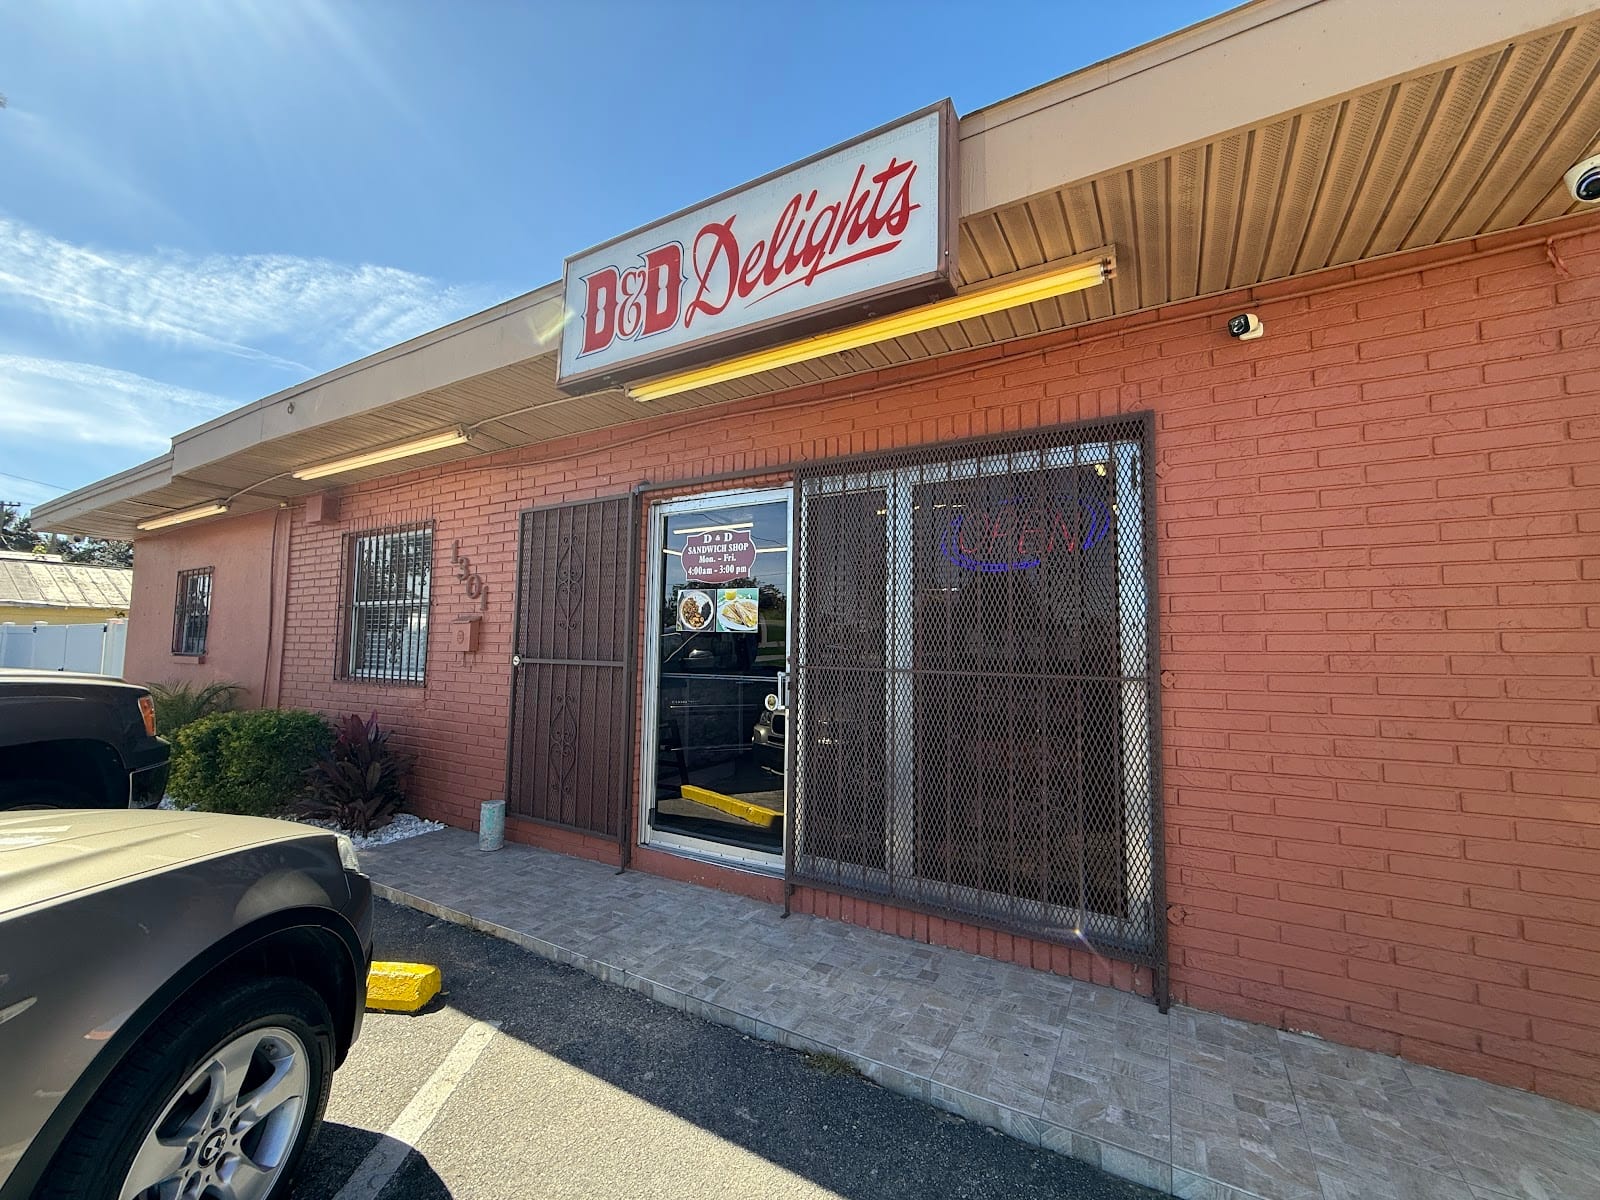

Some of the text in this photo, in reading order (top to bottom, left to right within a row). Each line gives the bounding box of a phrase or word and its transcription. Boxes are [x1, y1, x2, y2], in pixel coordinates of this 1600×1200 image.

[576, 157, 921, 359] D&D Delights
[703, 534, 712, 543] D
[724, 532, 733, 542] D
[688, 543, 749, 554] SANDWICH SHOP
[699, 555, 716, 563] Mon.
[723, 553, 737, 561] Fri.
[450, 540, 488, 611] 1301
[735, 566, 747, 575] pm
